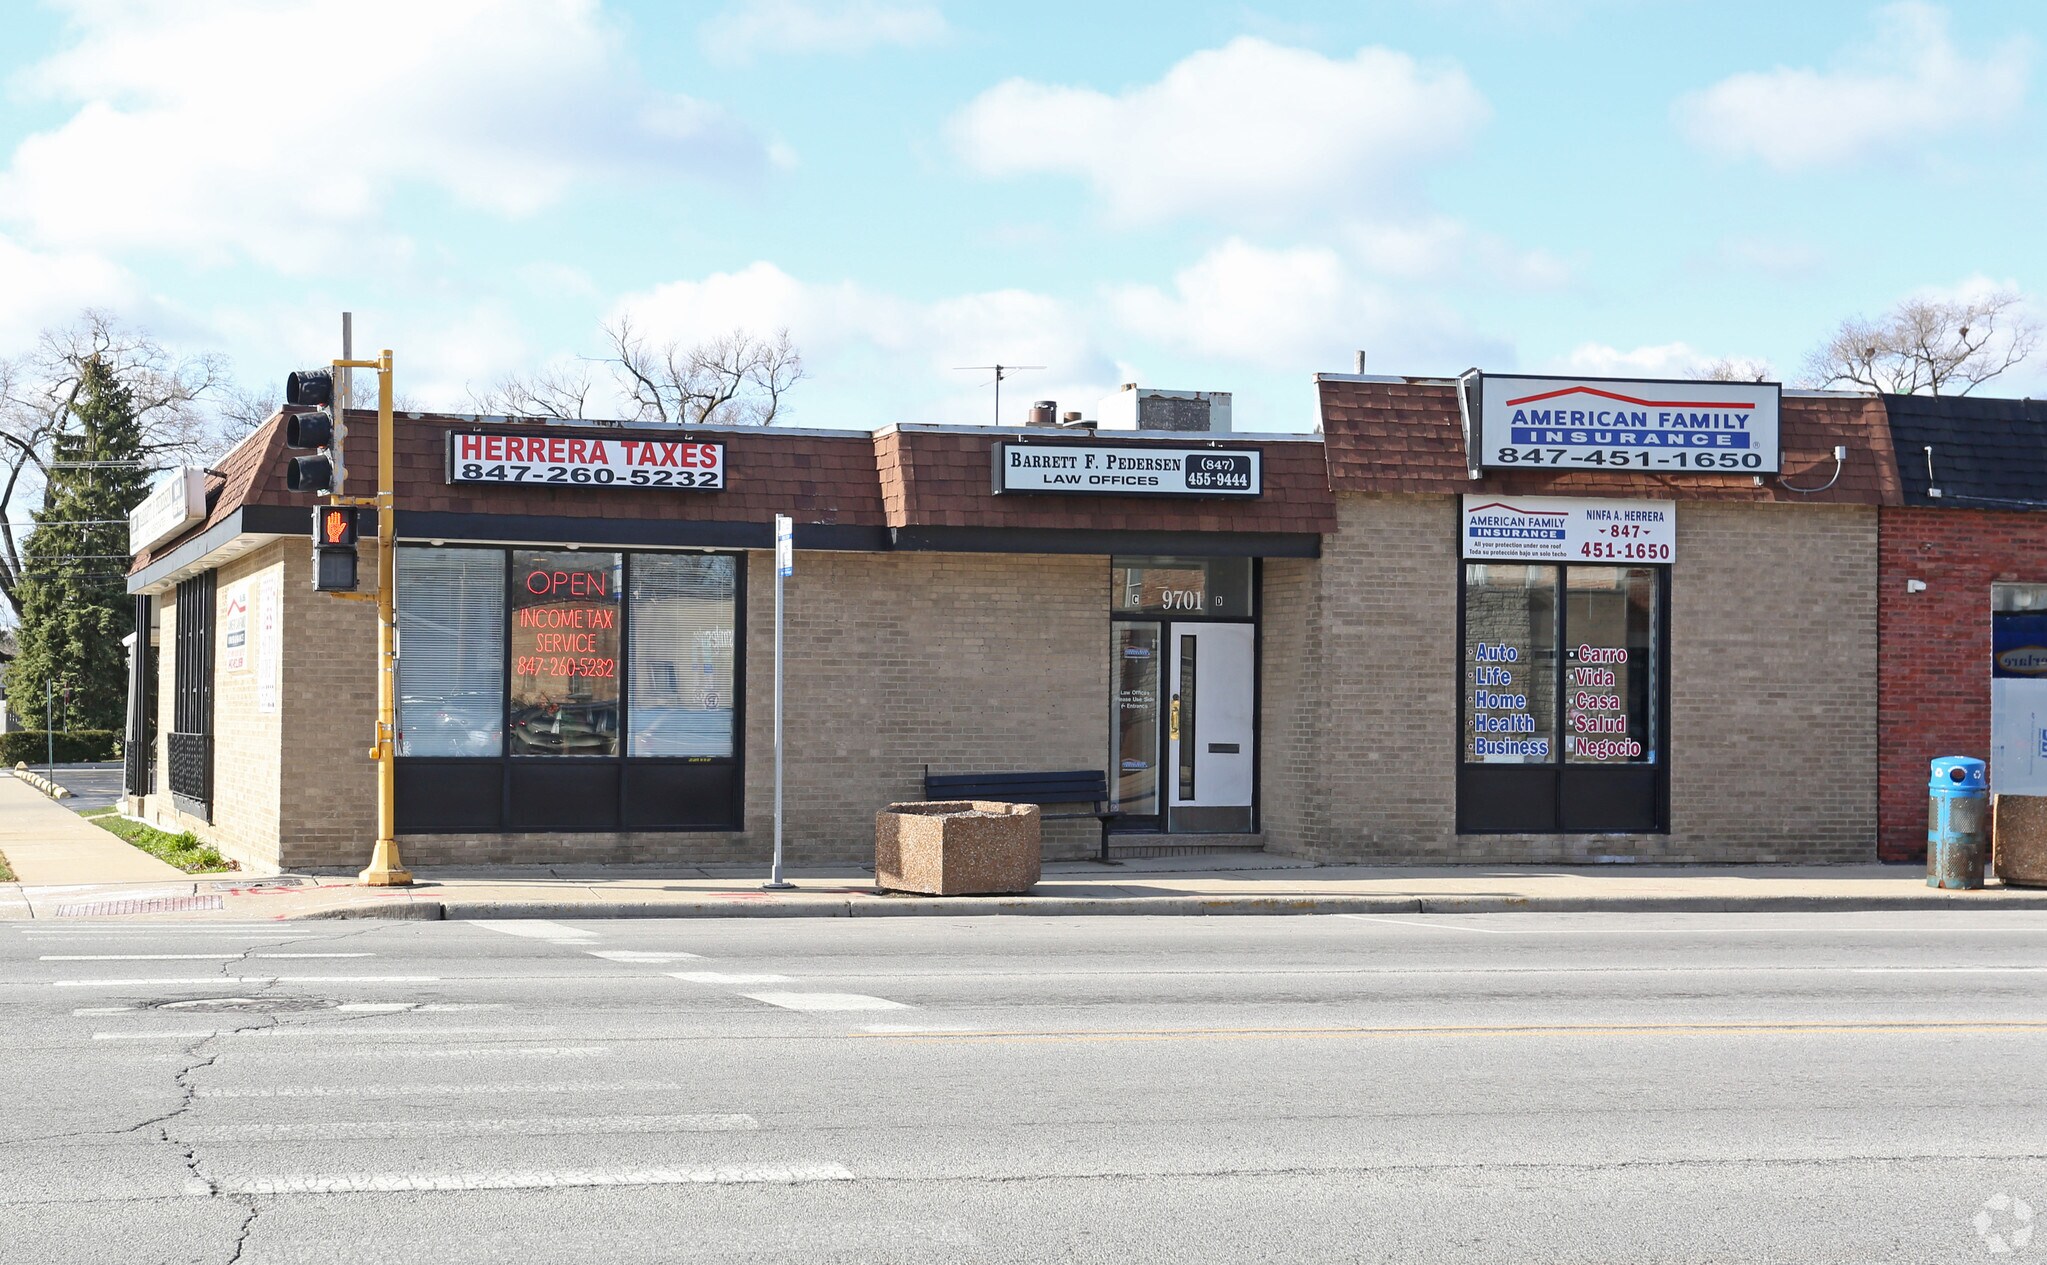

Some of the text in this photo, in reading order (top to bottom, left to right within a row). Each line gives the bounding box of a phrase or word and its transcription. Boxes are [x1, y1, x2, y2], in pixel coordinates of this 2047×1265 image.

[1511, 409, 1750, 430] AMERICAN FAMILY
[1530, 431, 1732, 446] INSURANCE
[461, 434, 718, 469] HERRERA TAXES
[1498, 448, 1762, 468] 847-451-1650
[1011, 452, 1182, 471] BARRETT F. PEDERSEN
[1200, 456, 1234, 471] (847)
[462, 463, 718, 488] 847-260-5232
[1044, 474, 1159, 486] LAW OFFICES
[1188, 472, 1248, 486] 455-9444
[1470, 516, 1565, 528] AMERICAN FAMILY
[1586, 510, 1664, 522] NINFA A. HERRERA
[1478, 528, 1557, 538] INSURANCE
[1611, 524, 1640, 538] 847
[1580, 542, 1670, 560] 451-1650
[527, 570, 606, 596] OPEN
[1132, 595, 1139, 604] C
[1162, 590, 1203, 610] 9701
[1216, 596, 1222, 606] D
[520, 608, 613, 629] INCOME TAX
[536, 633, 596, 653] SERVICE
[1476, 643, 1517, 661] Auto
[1578, 644, 1628, 663] Carro
[516, 656, 614, 678] 847-260-5232
[1476, 666, 1512, 686] Life
[1575, 668, 1615, 686] Vida
[1475, 690, 1526, 709] Home
[1576, 692, 1620, 710] Casa
[1475, 714, 1535, 732] Health
[1575, 714, 1626, 734] Salud
[1475, 737, 1548, 755] Business
[1576, 738, 1641, 760] Negocio
